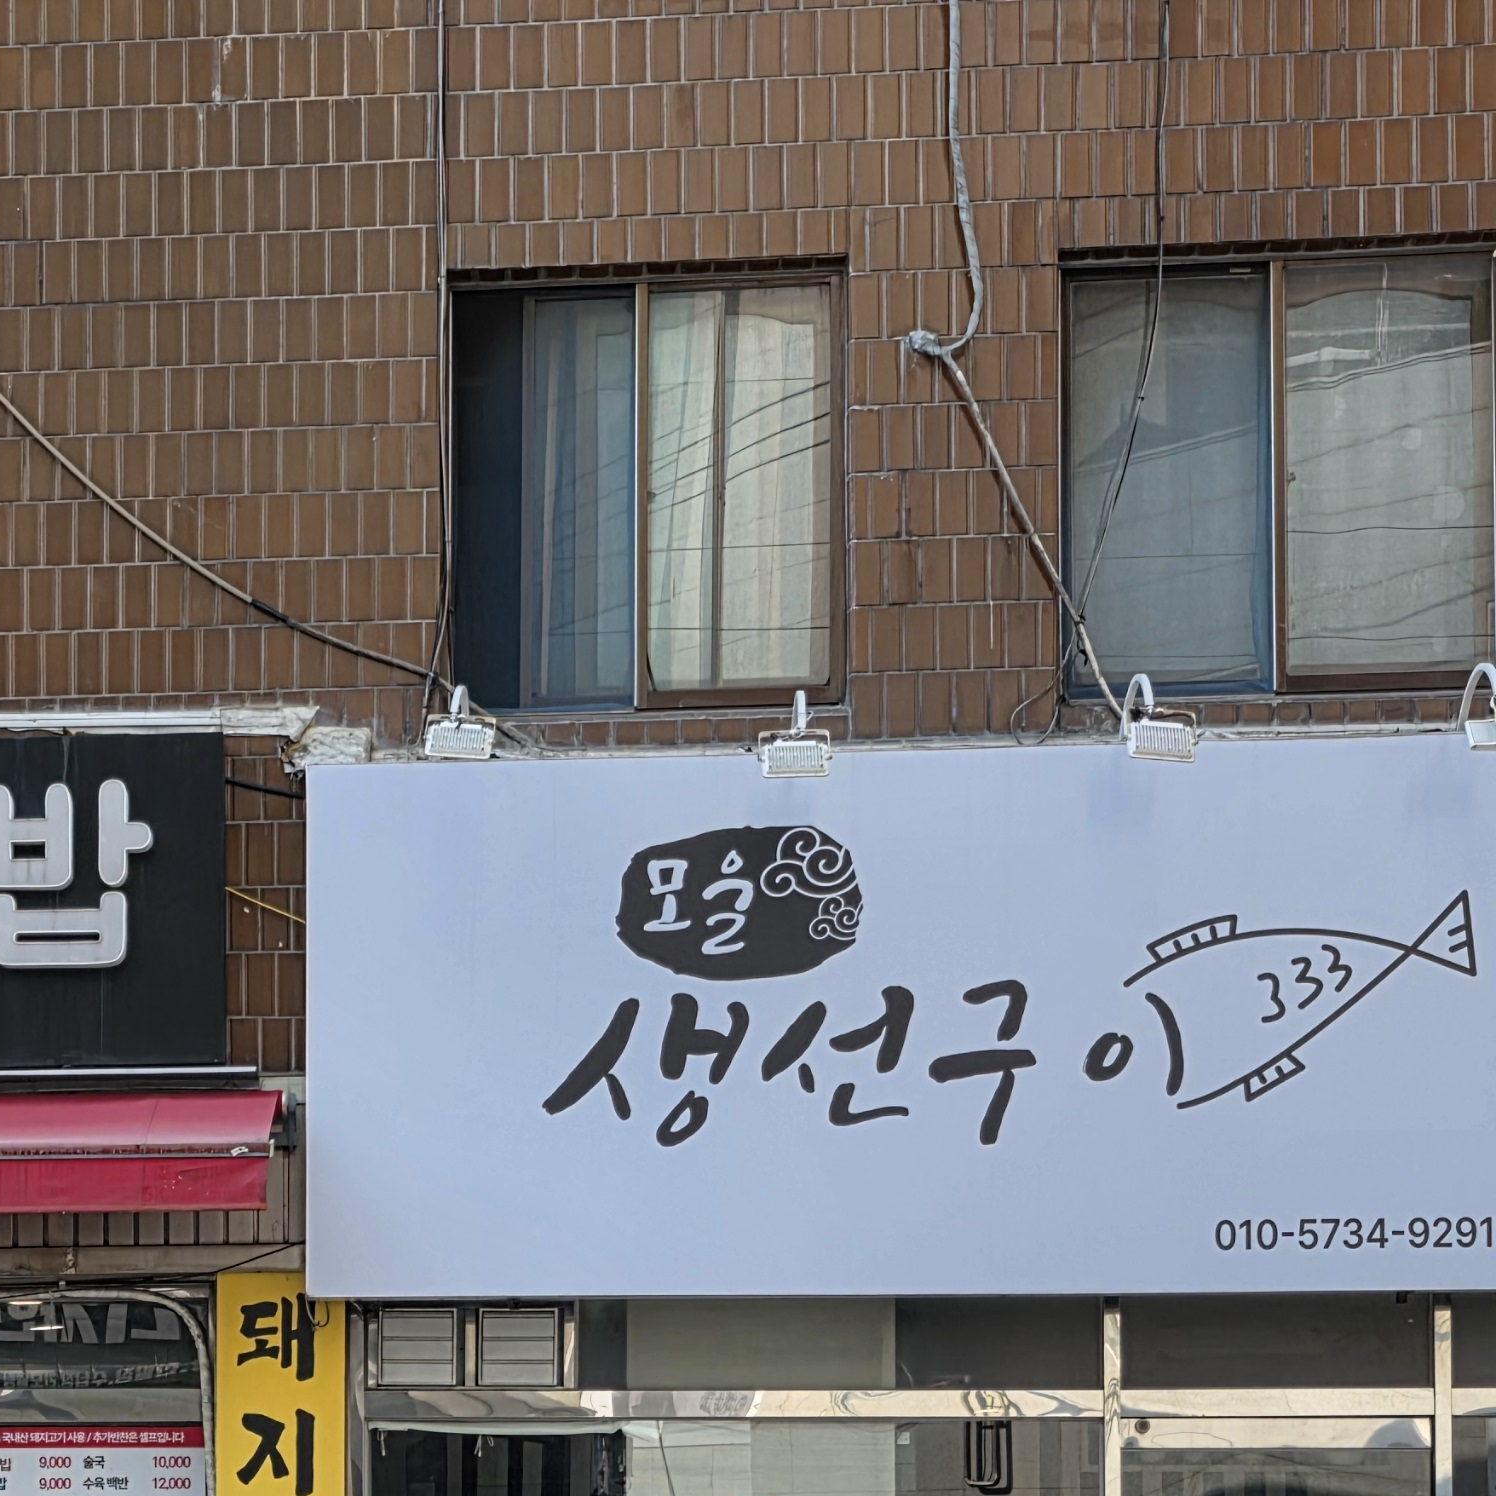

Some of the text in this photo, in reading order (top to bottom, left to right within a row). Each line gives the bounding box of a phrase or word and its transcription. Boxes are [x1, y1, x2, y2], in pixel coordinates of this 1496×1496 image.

[644, 849, 755, 956] 모울
[541, 984, 1184, 1147] 생선구이
[1214, 1217, 1494, 1252] 010-5734-9291
[2, 1432, 29, 1443] 국내산
[30, 1432, 66, 1443] 돼지고기
[67, 1432, 85, 1443] 사용
[92, 1432, 138, 1443] 추가반찬은
[39, 1456, 72, 1470] 9,000
[83, 1455, 105, 1469] 술국
[152, 1456, 192, 1469] 10,000
[39, 1477, 72, 1491] 9,000
[83, 1477, 129, 1490] 수육 백반
[152, 1477, 192, 1490] 12,000
